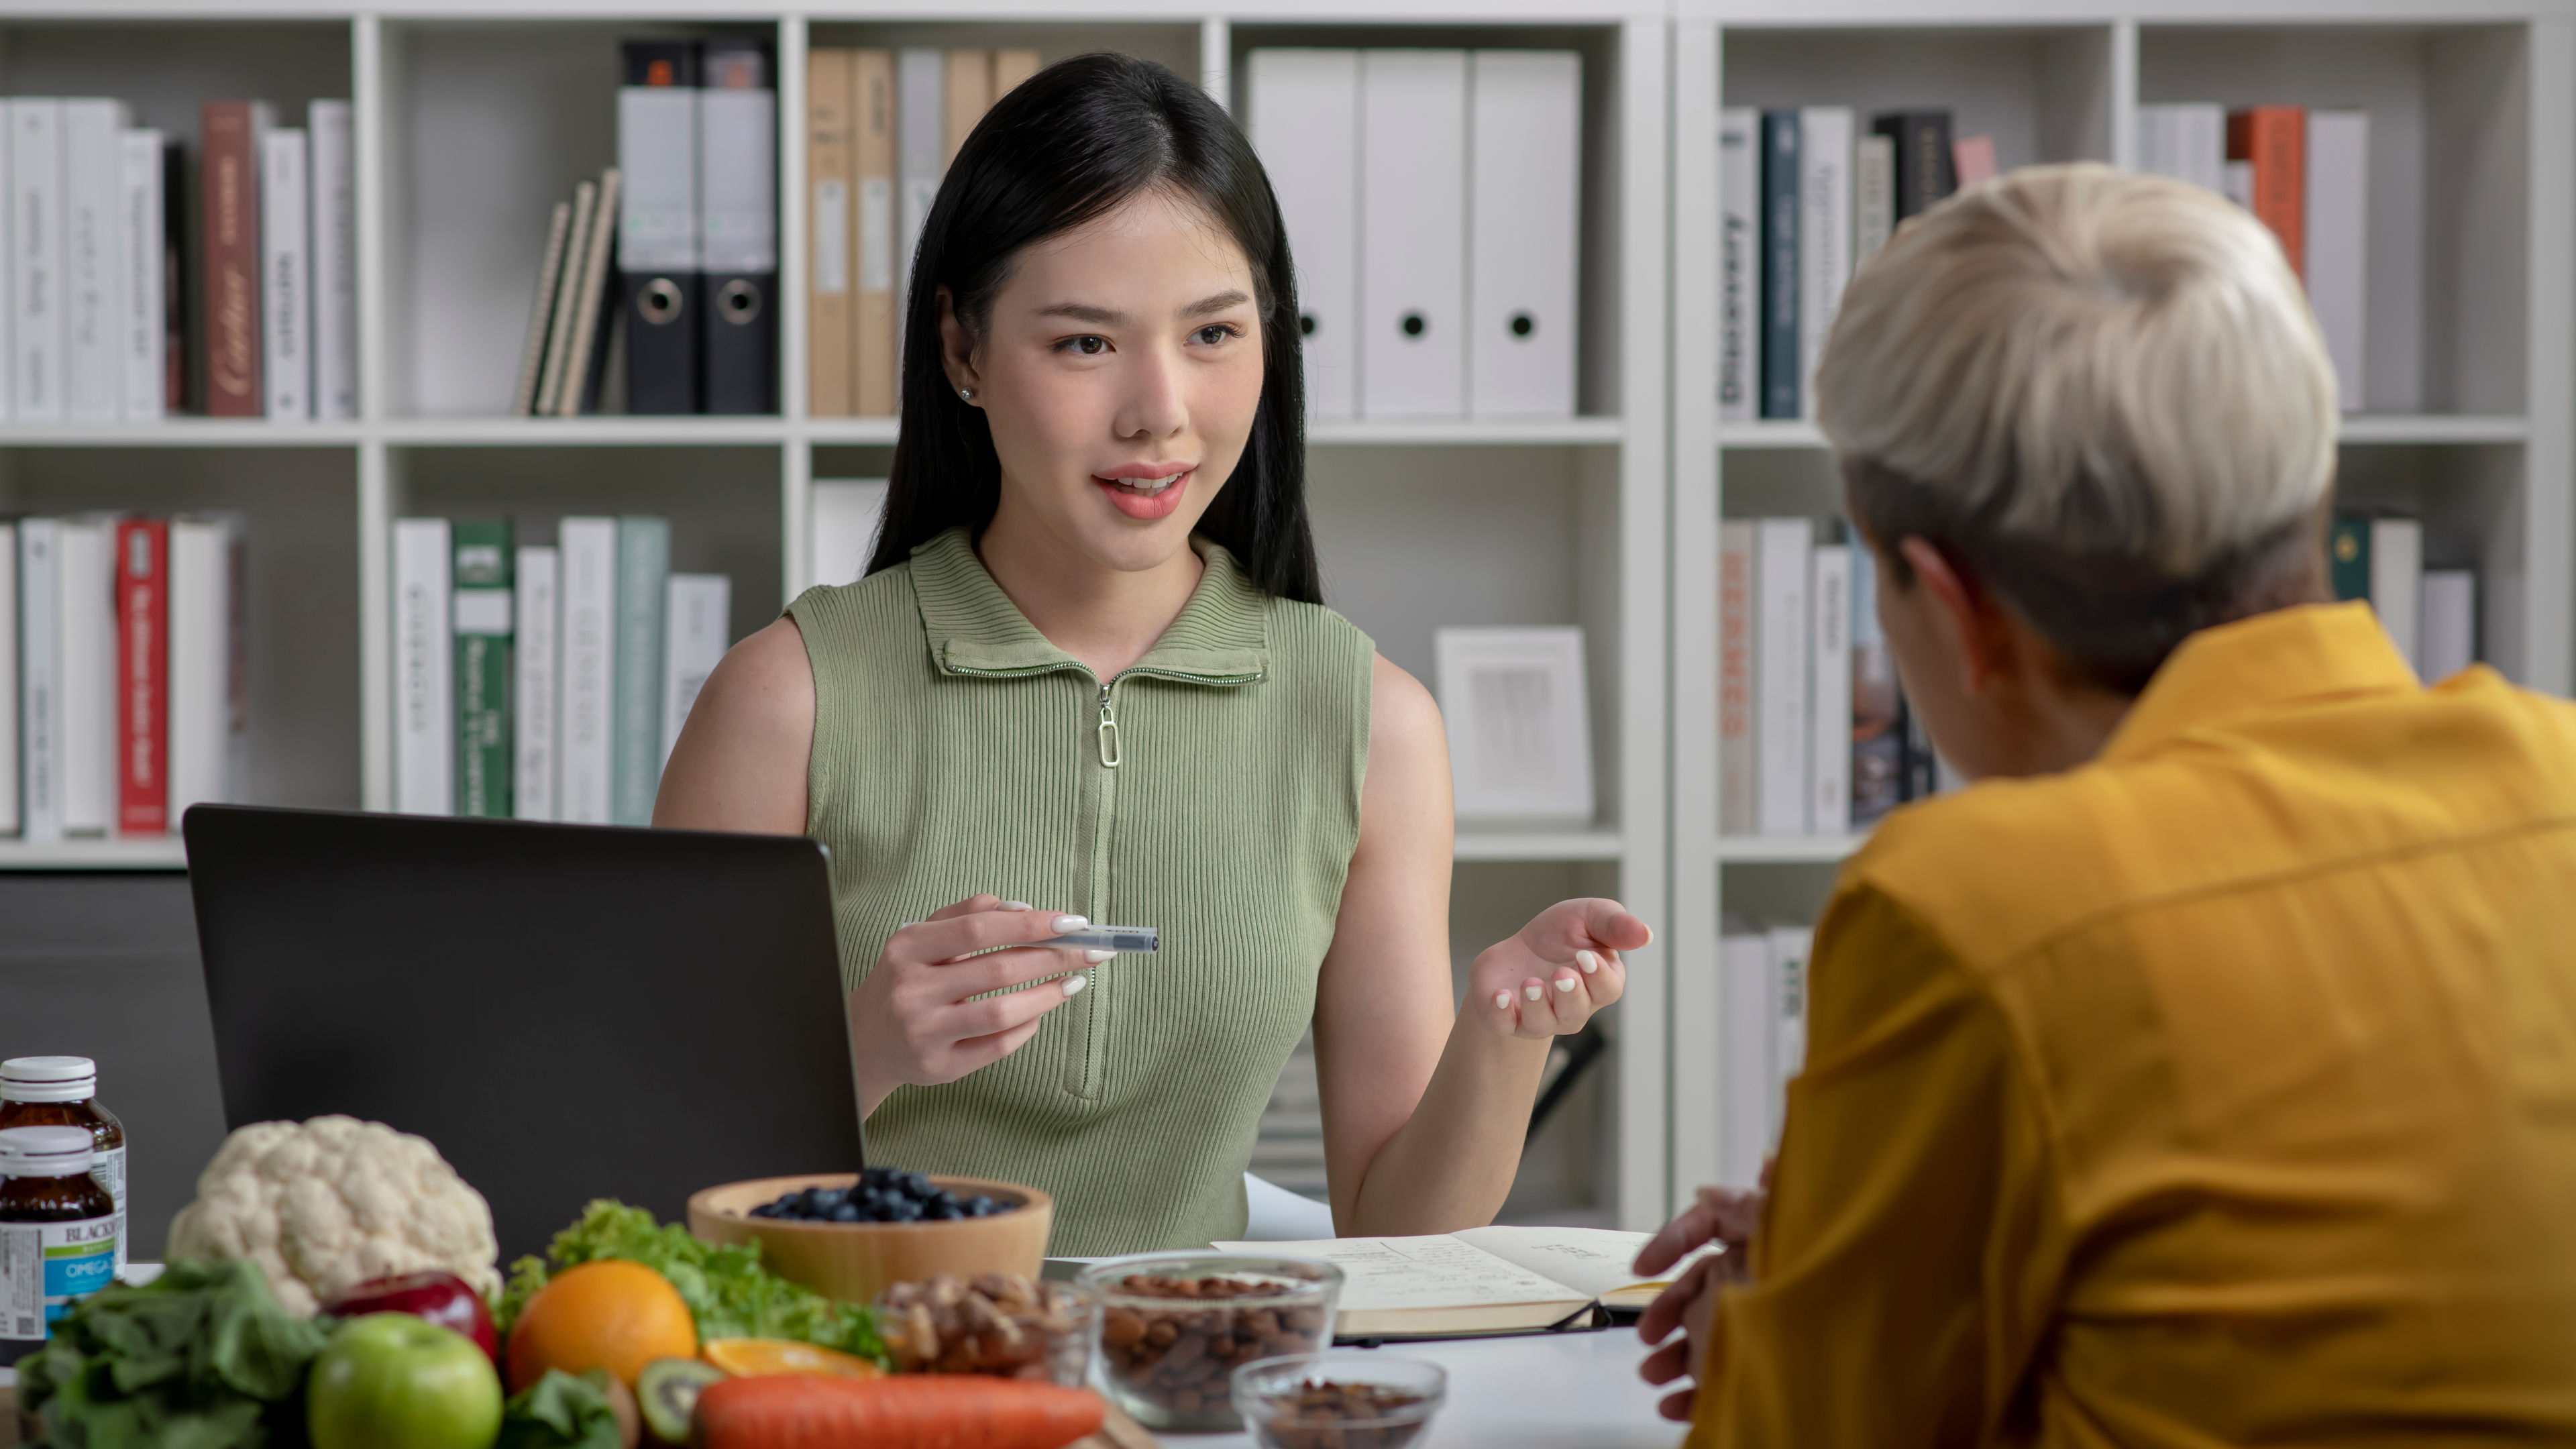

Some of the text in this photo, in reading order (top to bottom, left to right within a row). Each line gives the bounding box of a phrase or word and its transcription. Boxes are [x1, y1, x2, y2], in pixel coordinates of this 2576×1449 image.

[213, 264, 252, 396] Cartier
[1720, 213, 1746, 403] Discovery
[407, 584, 427, 733] GIVENCHY
[1721, 554, 1748, 739] HERMES
[66, 1222, 115, 1242] BLACK
